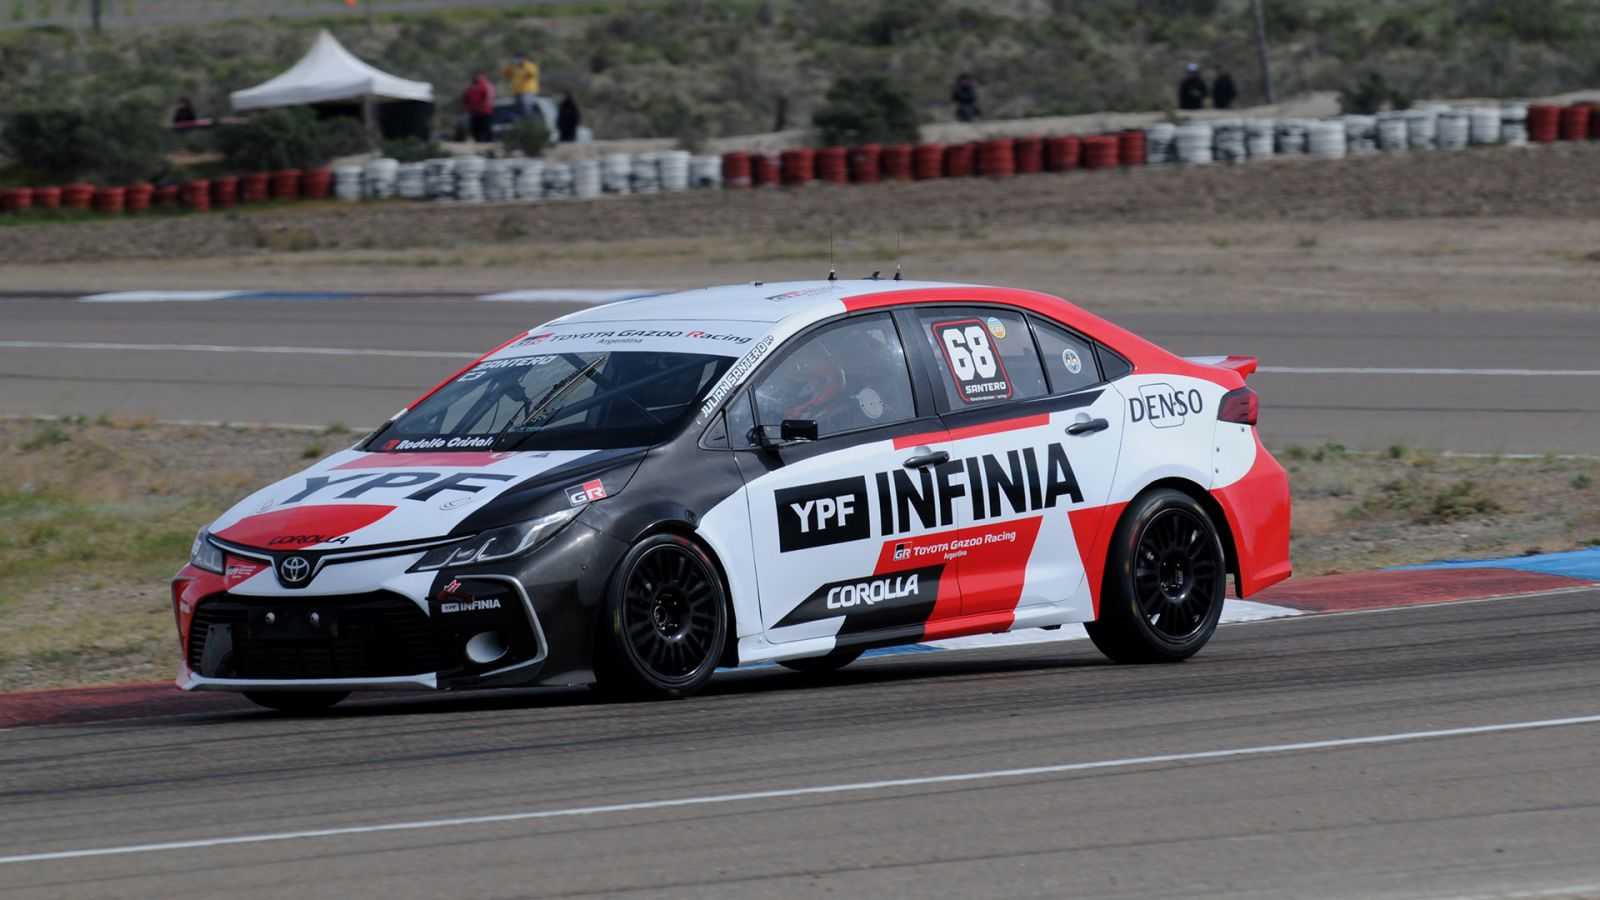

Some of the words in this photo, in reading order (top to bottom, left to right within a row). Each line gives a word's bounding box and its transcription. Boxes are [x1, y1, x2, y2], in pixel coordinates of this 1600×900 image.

[549, 331, 614, 342] TOYOTA
[685, 331, 752, 344] Racing
[598, 338, 643, 346] Argentina
[943, 326, 997, 381] 68
[472, 355, 558, 372] SANTERO
[965, 381, 1006, 394] SANTERO
[1129, 389, 1203, 423] DENSO
[395, 438, 445, 450] Rodolfo
[279, 472, 518, 504] YPF
[571, 487, 602, 503] GR
[876, 442, 1083, 536] INFINIA
[790, 494, 855, 533] YPF
[268, 534, 350, 547] COROLLA
[894, 548, 910, 559] GR
[913, 545, 949, 555] TOYOTA
[950, 537, 981, 549] GAZOO
[983, 531, 1016, 544] Racing
[943, 550, 967, 559] Argentina
[826, 574, 919, 609] COROLLA
[460, 599, 501, 611] INFINIA
